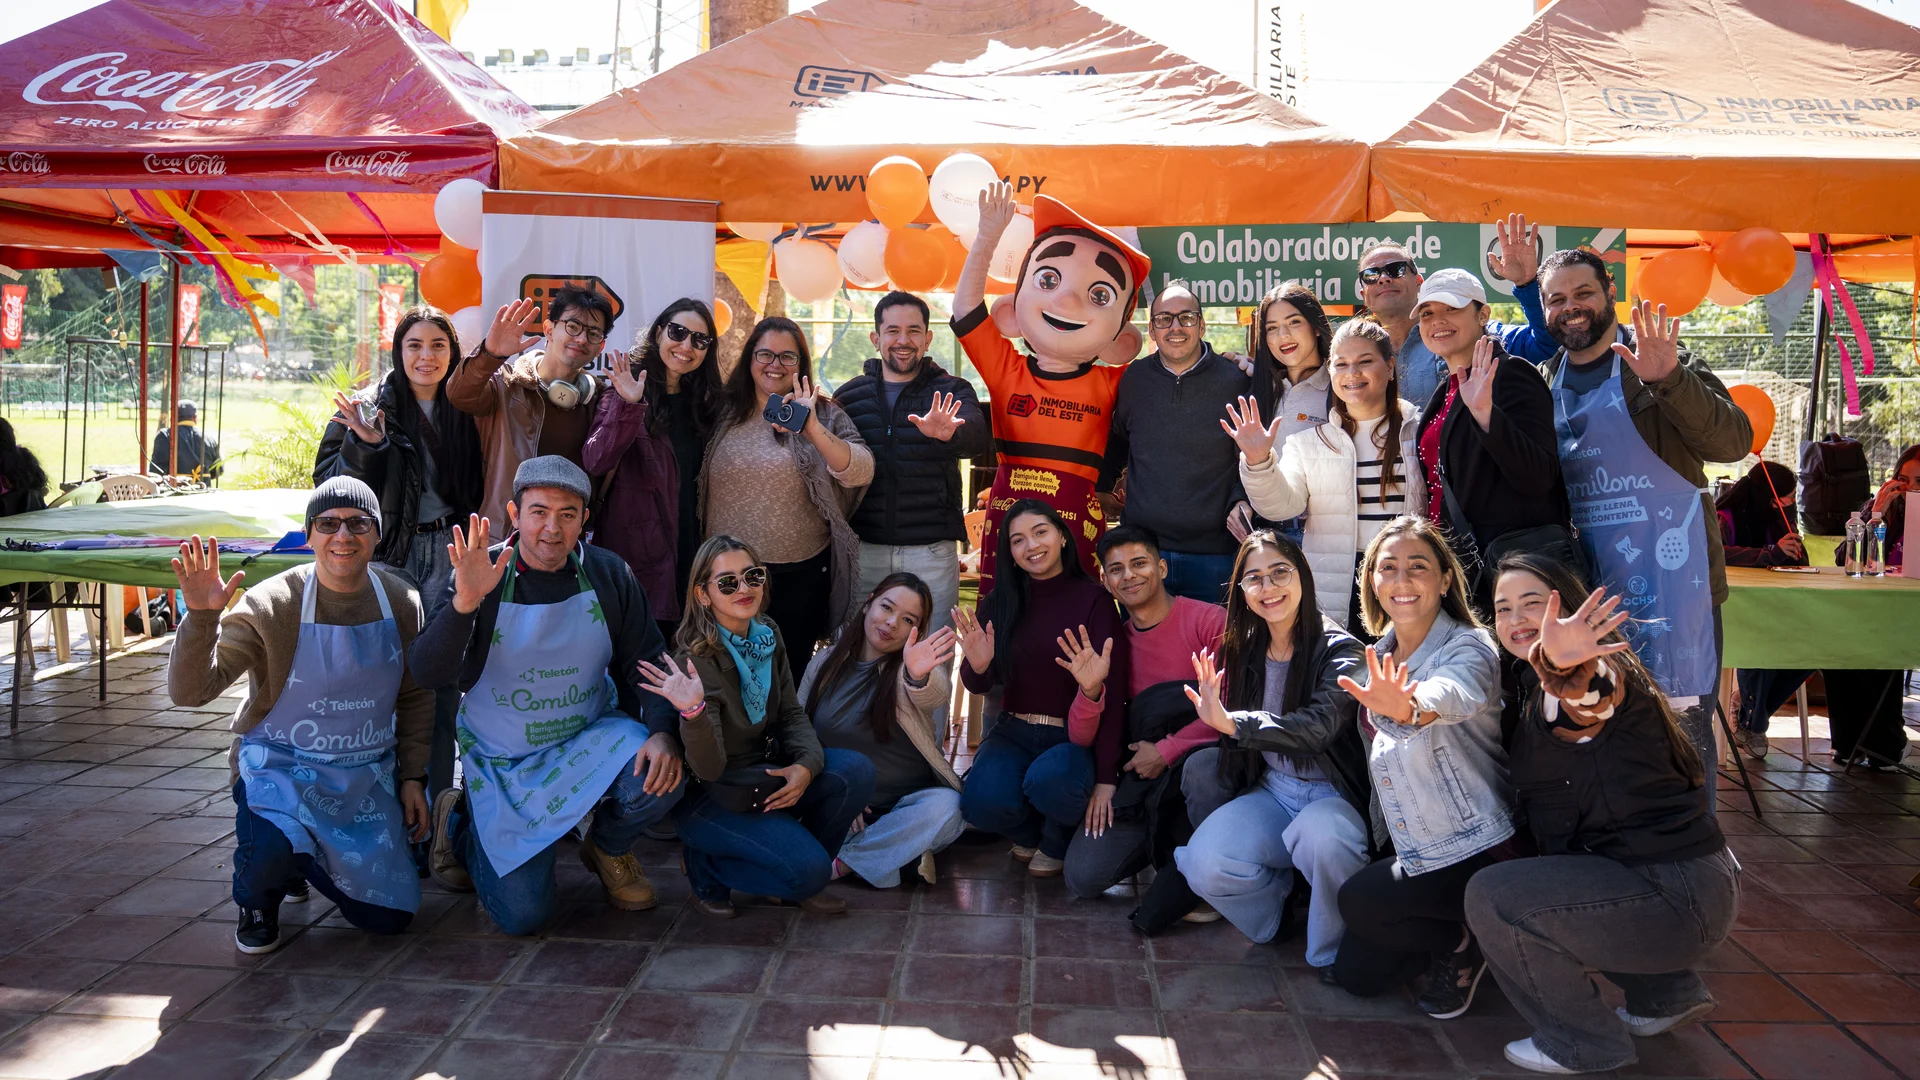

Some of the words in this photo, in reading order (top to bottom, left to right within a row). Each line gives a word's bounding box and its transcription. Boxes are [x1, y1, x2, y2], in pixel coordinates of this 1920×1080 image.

[22, 46, 350, 113] Coca-Cola
[1716, 97, 1920, 111] INMOBILIARIA
[54, 116, 118, 129] ZERO
[123, 117, 247, 130] AZÚCARES
[1724, 111, 1784, 124] DEL
[1788, 112, 1865, 126] ESTE
[1848, 130, 1920, 138] INVERS
[143, 153, 227, 175] Coca-Cola
[326, 150, 412, 178] Coca-Cola
[1177, 226, 1393, 264] Colaboradore
[1406, 224, 1441, 260] de
[1040, 396, 1102, 416] INMOBILIARIA
[1038, 406, 1057, 418] DEL
[1059, 410, 1084, 422] ESTE
[1566, 465, 1655, 497] omilona
[1603, 500, 1636, 511] LLENA,
[1591, 509, 1643, 523] CONTENTO
[537, 666, 579, 679] Teletón
[329, 698, 375, 711] Teletón
[353, 813, 387, 823] OCHSI
